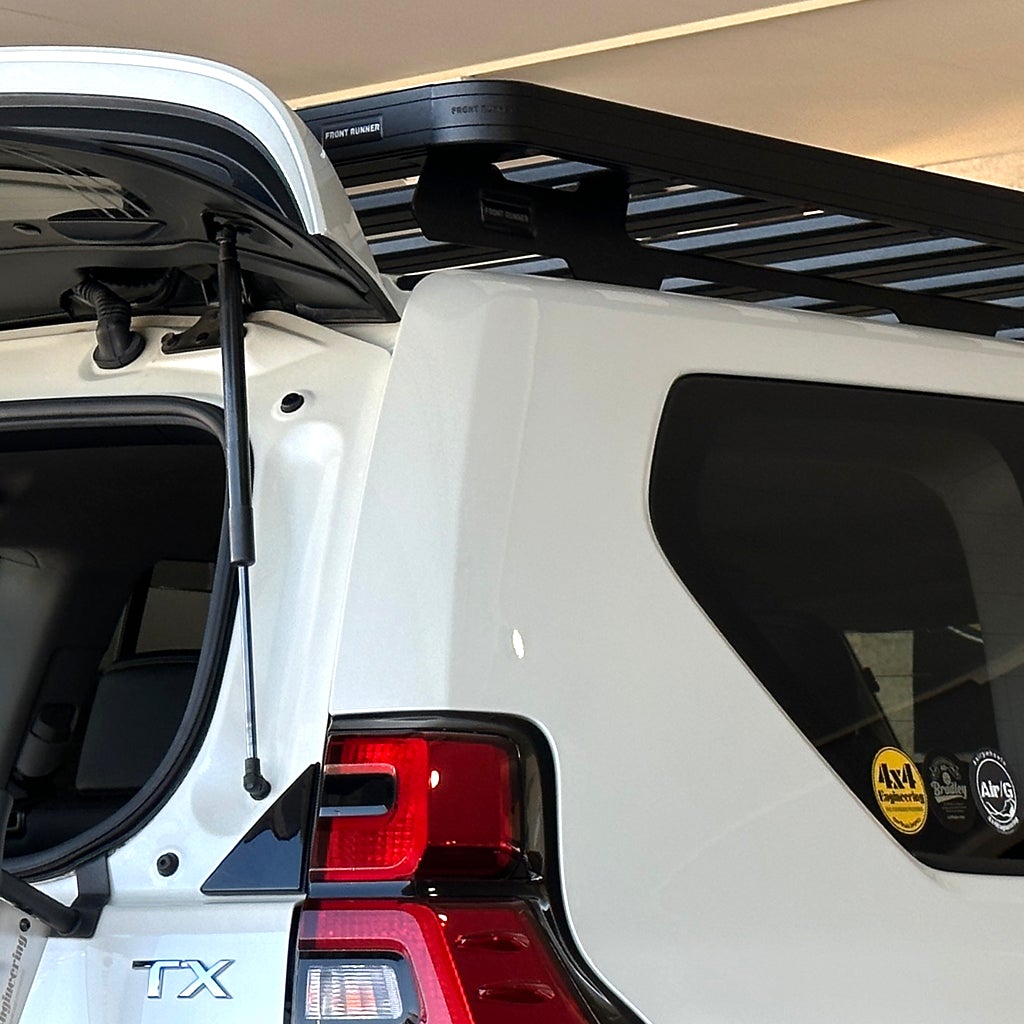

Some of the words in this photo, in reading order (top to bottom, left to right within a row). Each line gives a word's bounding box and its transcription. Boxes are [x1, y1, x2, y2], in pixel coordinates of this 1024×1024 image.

[324, 127, 349, 140] FRONT
[350, 123, 380, 136] RUNNER
[879, 763, 916, 789] 4x4
[131, 959, 236, 999] TX
